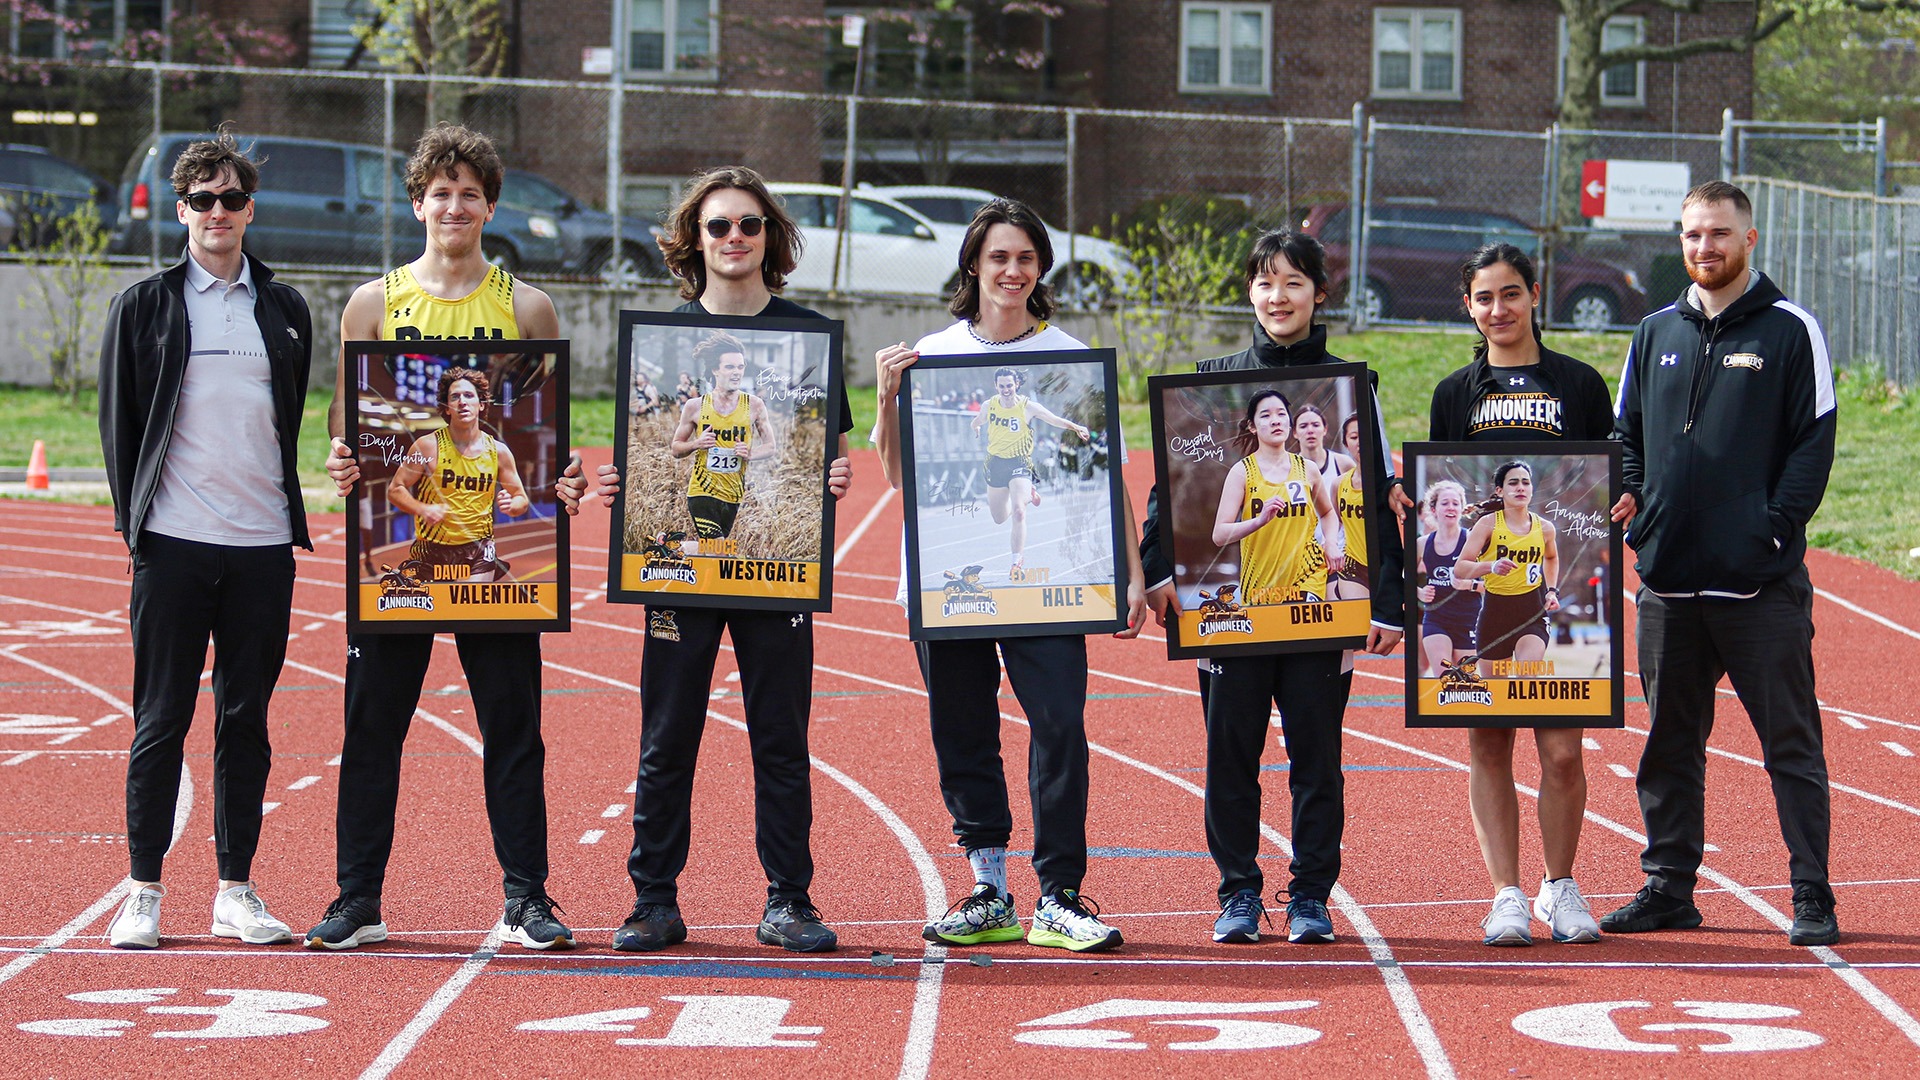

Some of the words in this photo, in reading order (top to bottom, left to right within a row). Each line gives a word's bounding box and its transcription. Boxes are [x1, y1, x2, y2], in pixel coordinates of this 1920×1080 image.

[1010, 419, 1019, 431] 5
[1469, 399, 1562, 431] ANNONEERS
[1473, 420, 1504, 431] TRACK
[1522, 420, 1553, 431] FIELD
[359, 432, 396, 448] David
[711, 455, 739, 469] 213
[441, 468, 493, 492] Pratt
[1288, 481, 1305, 503] 2
[1251, 498, 1307, 520] Patt
[699, 537, 738, 555] BRUCE
[1496, 544, 1541, 564] Pratt
[433, 564, 471, 581] DAVID
[640, 567, 697, 585] CANNONEERS
[719, 559, 807, 583] WESTGATE
[377, 596, 434, 612] CANNONEERS
[449, 584, 539, 605] VALENTINE
[1042, 586, 1084, 607] HALE
[1251, 586, 1304, 603] CRYSTAL
[941, 600, 998, 618] CANNONEERS
[1290, 603, 1334, 625] DENG
[1198, 619, 1254, 637] CANNONEERS
[1492, 660, 1556, 676] FERNANDA
[1437, 691, 1494, 706] CANNONEERS
[1507, 680, 1590, 700] ALATORRE
[16, 988, 330, 1038] 3
[516, 994, 824, 1048] 4
[1013, 999, 1322, 1051] 5
[1511, 1000, 1826, 1053] 6
